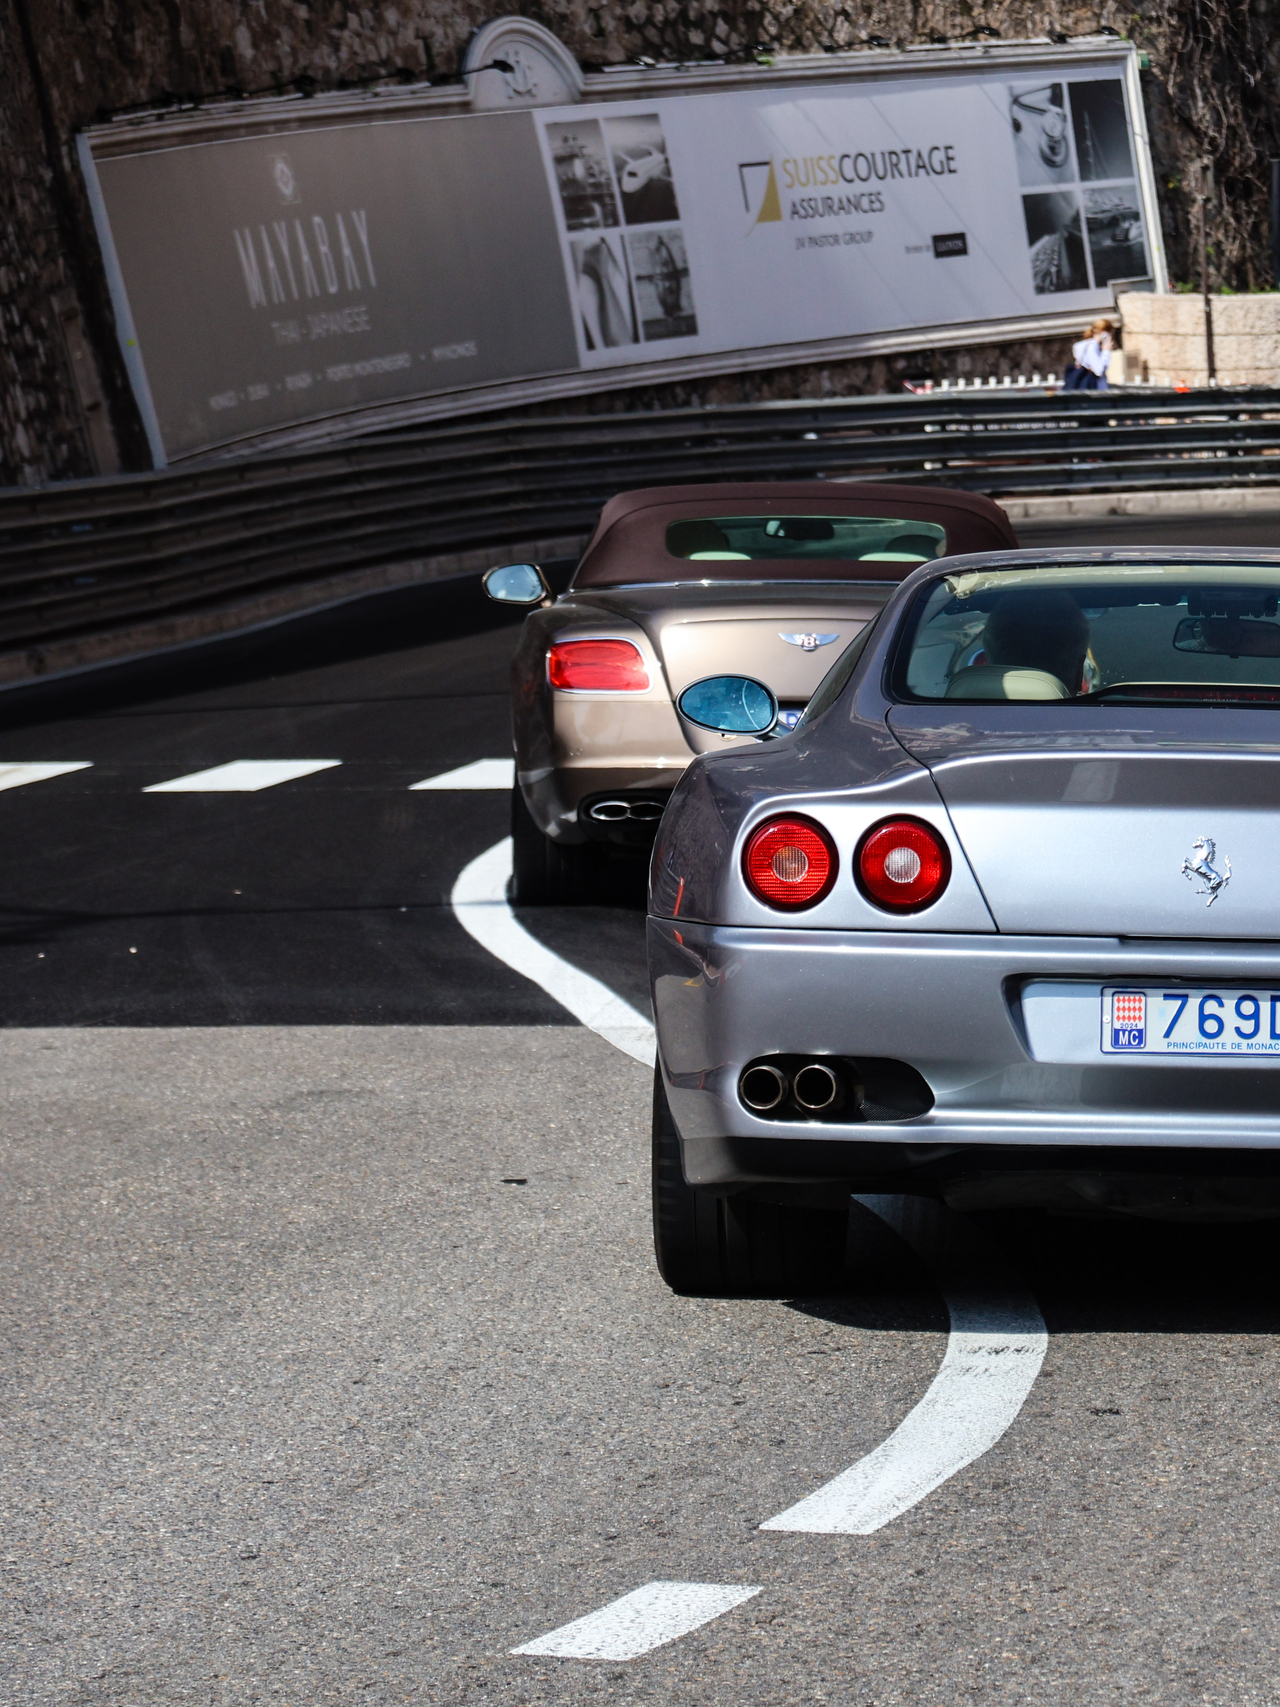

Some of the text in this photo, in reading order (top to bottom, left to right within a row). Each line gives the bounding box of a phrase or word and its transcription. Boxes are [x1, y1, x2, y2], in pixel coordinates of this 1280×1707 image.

[782, 145, 958, 189] SUISSCOURTAGE
[790, 192, 885, 221] ASSURANCES
[808, 235, 841, 249] PASTOR
[843, 231, 874, 245] GROUP
[233, 209, 377, 309] MAYABAY
[1119, 1031, 1139, 1046] MC
[1167, 1042, 1227, 1050] PRINCIPAUTE
[1231, 1042, 1243, 1050] DE
